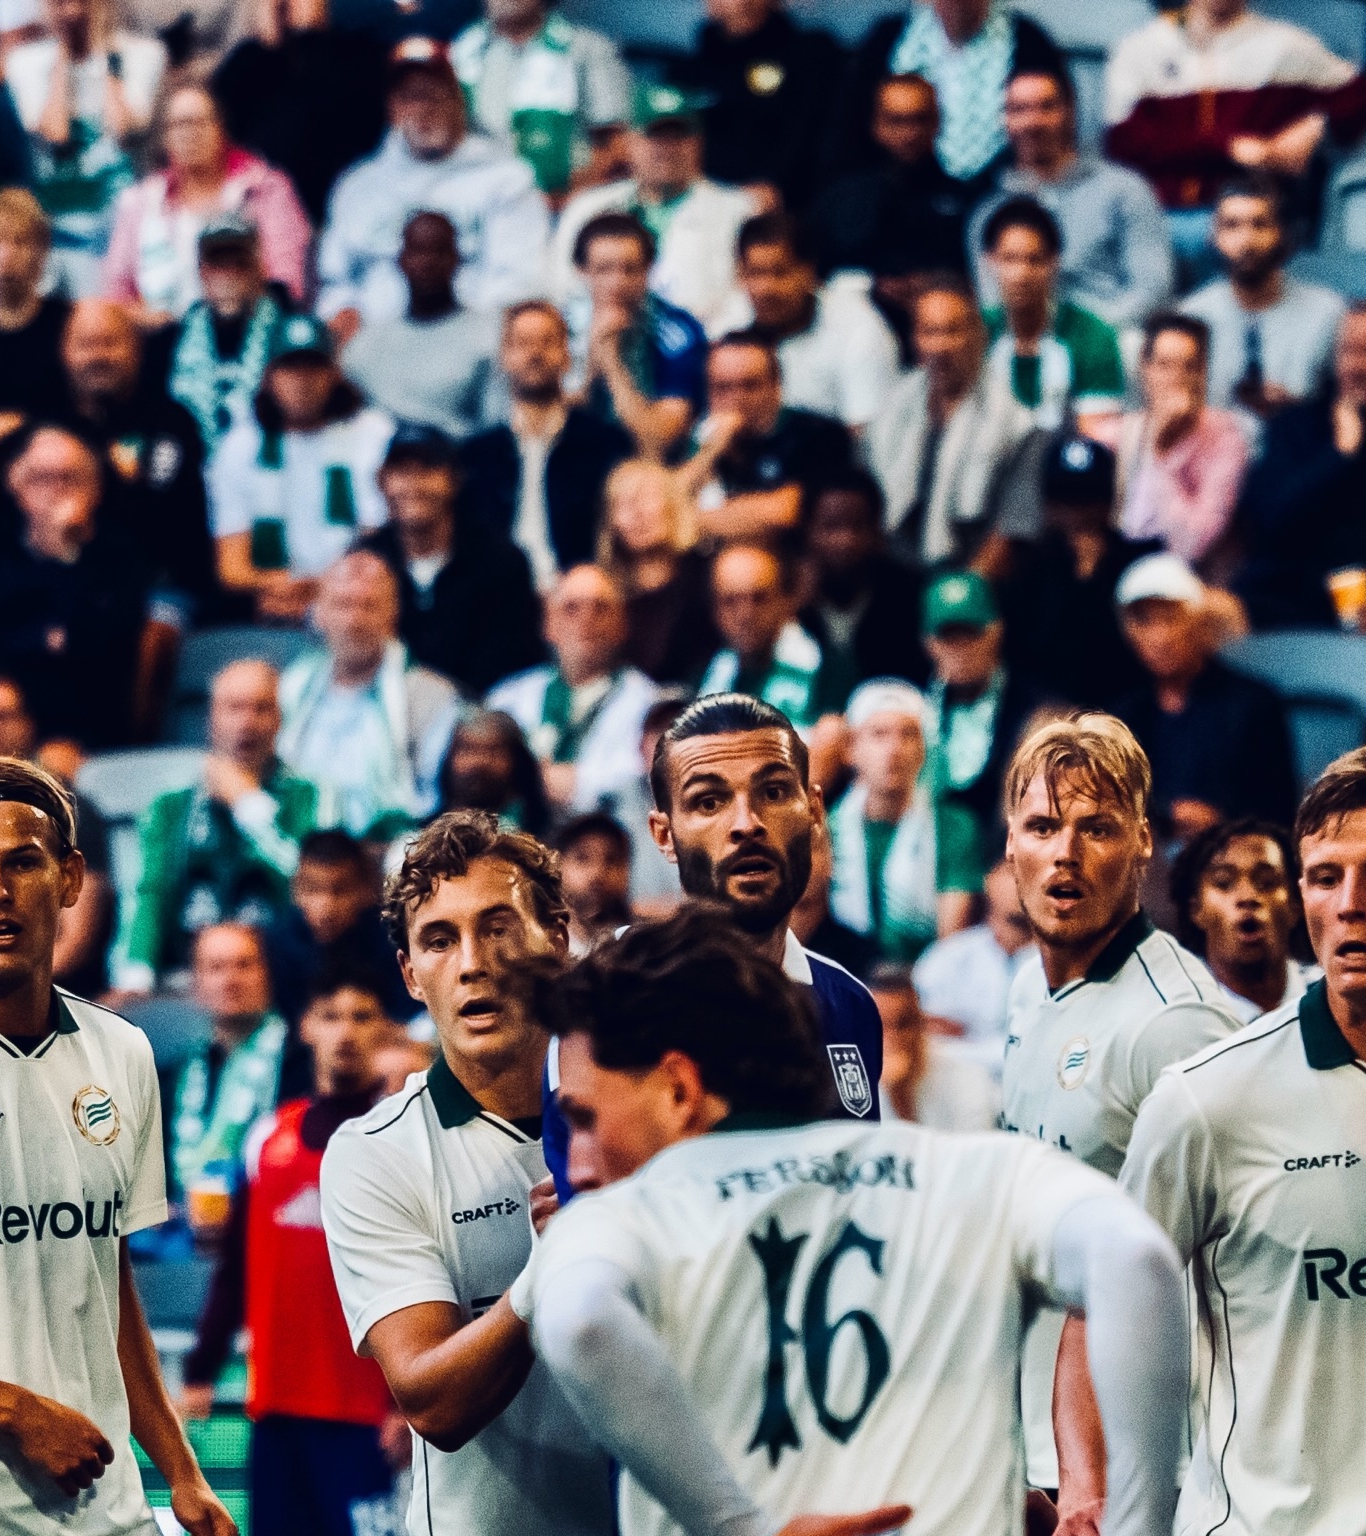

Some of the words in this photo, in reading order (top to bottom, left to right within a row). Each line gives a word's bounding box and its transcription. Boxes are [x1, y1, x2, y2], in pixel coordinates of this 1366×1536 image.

[1283, 1153, 1343, 1172] CRAFT
[451, 1202, 504, 1225] CRAFT
[744, 1215, 892, 1471] 16
